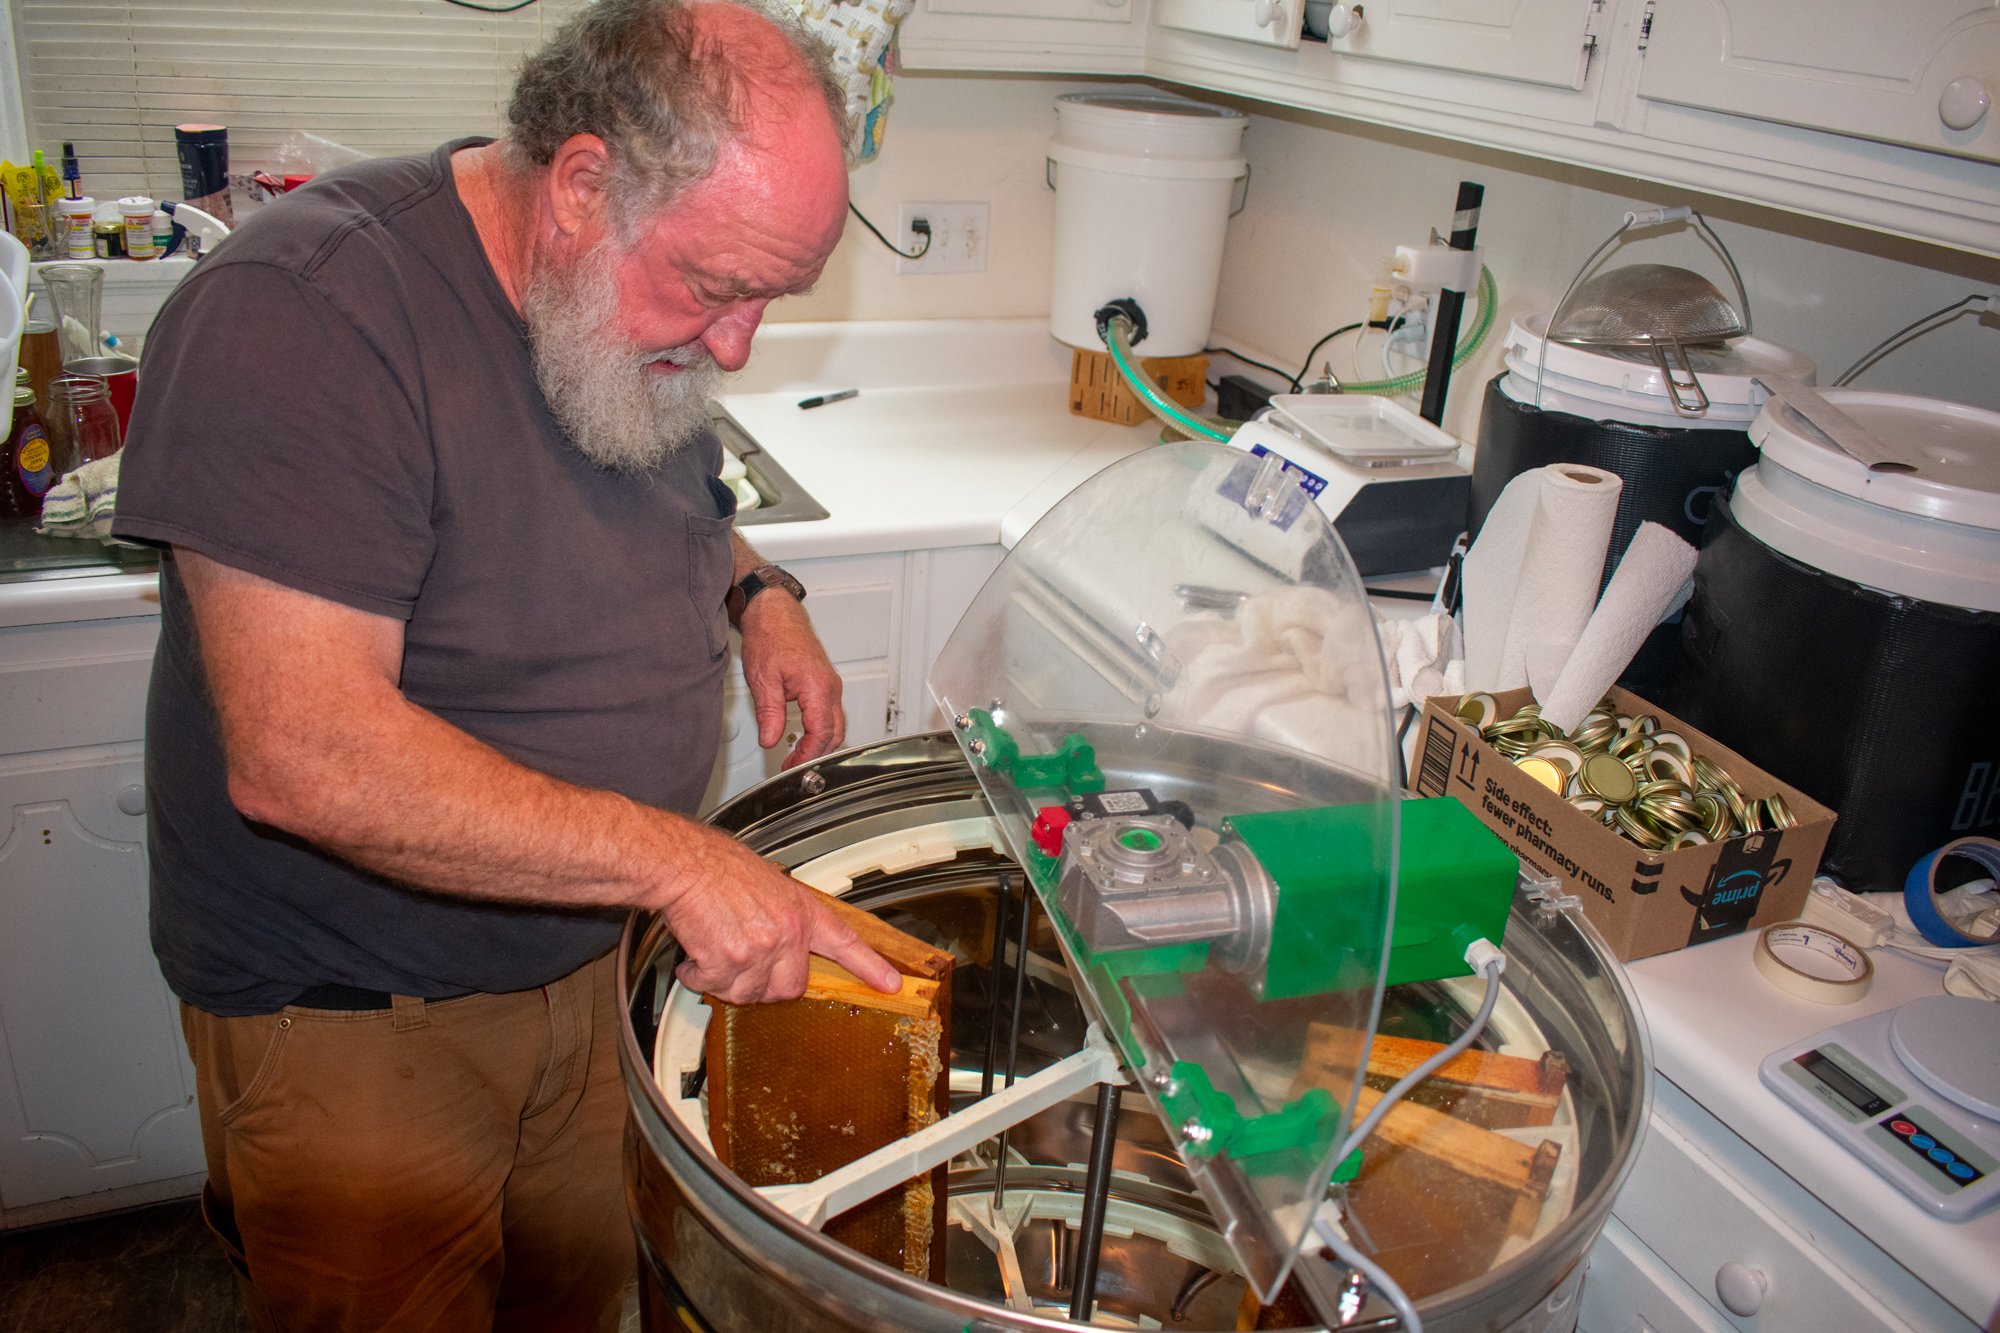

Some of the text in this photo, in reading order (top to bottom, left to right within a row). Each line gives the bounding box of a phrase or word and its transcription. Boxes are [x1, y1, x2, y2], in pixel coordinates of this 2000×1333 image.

[1485, 777, 1553, 838] Side effect:
[1950, 761, 2000, 831] BE
[1481, 794, 1616, 905] fewer pharmacy runs.
[1711, 880, 1761, 906] prime
